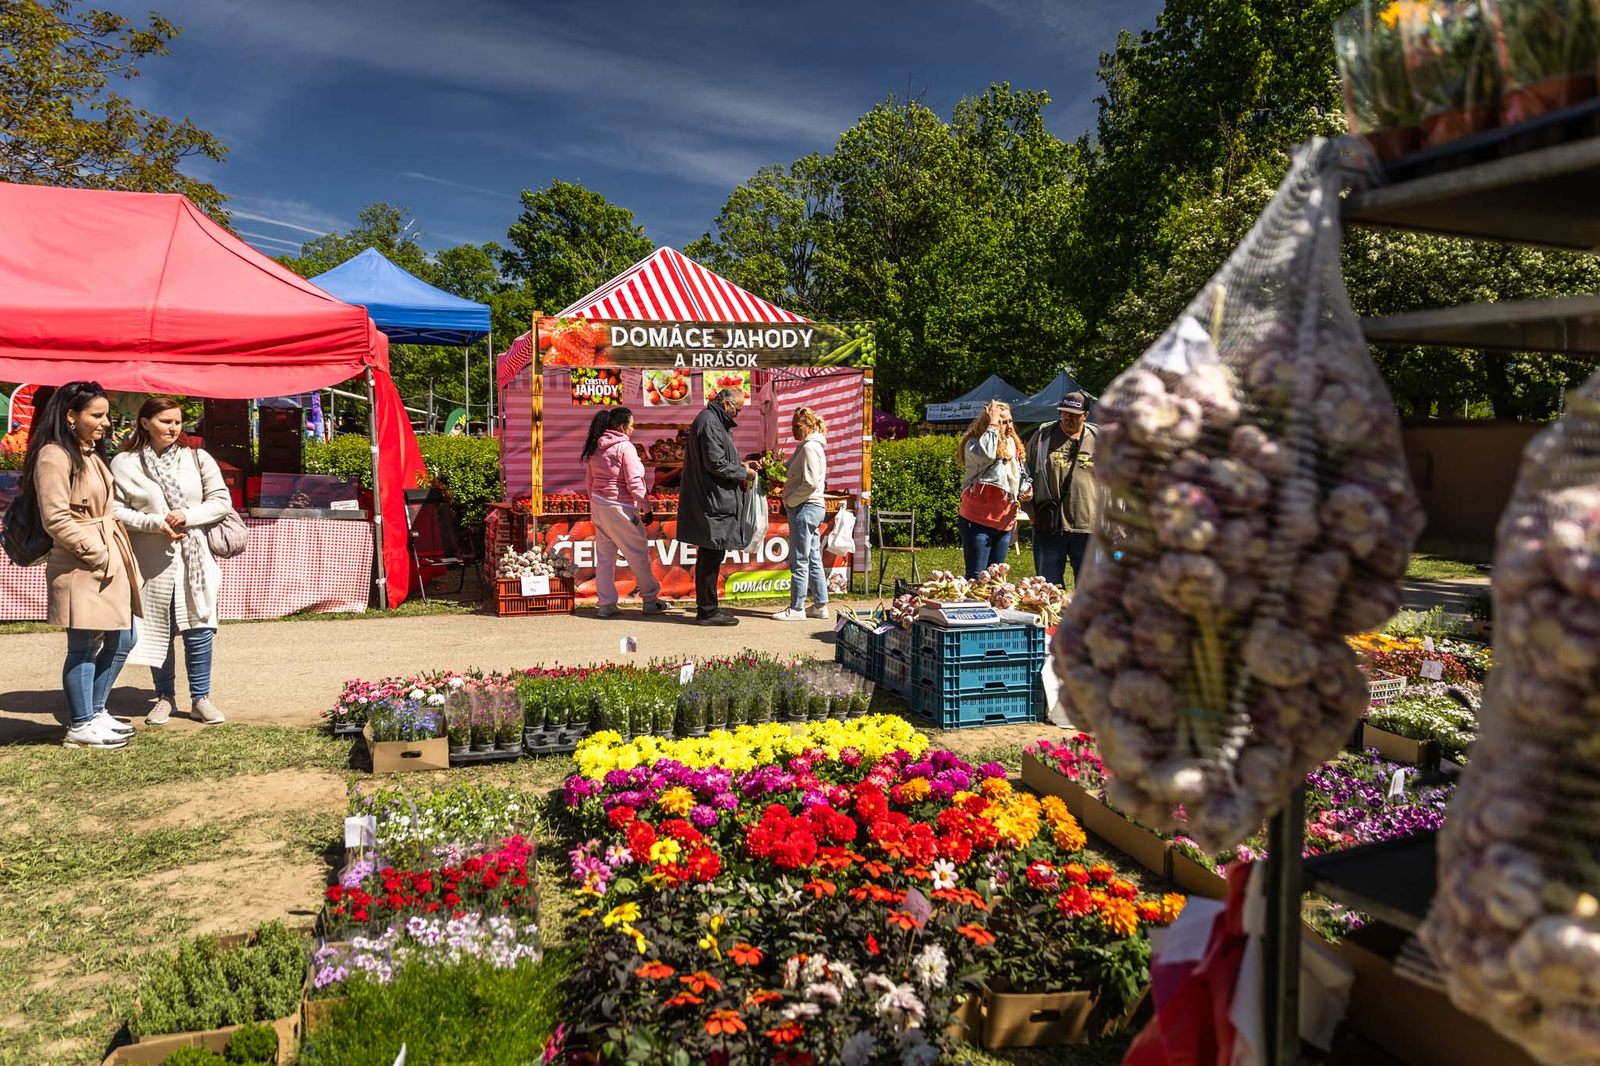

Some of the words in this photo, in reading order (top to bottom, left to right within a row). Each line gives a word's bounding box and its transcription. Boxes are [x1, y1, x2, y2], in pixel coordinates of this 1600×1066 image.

[611, 323, 716, 348] DOMÁCE
[722, 328, 813, 349] JAHODY
[674, 352, 686, 367] A
[692, 350, 758, 368] HRÁŠOK
[575, 384, 619, 396] JAHODY
[732, 578, 772, 593] DOMÁCI
[773, 579, 791, 591] CES
